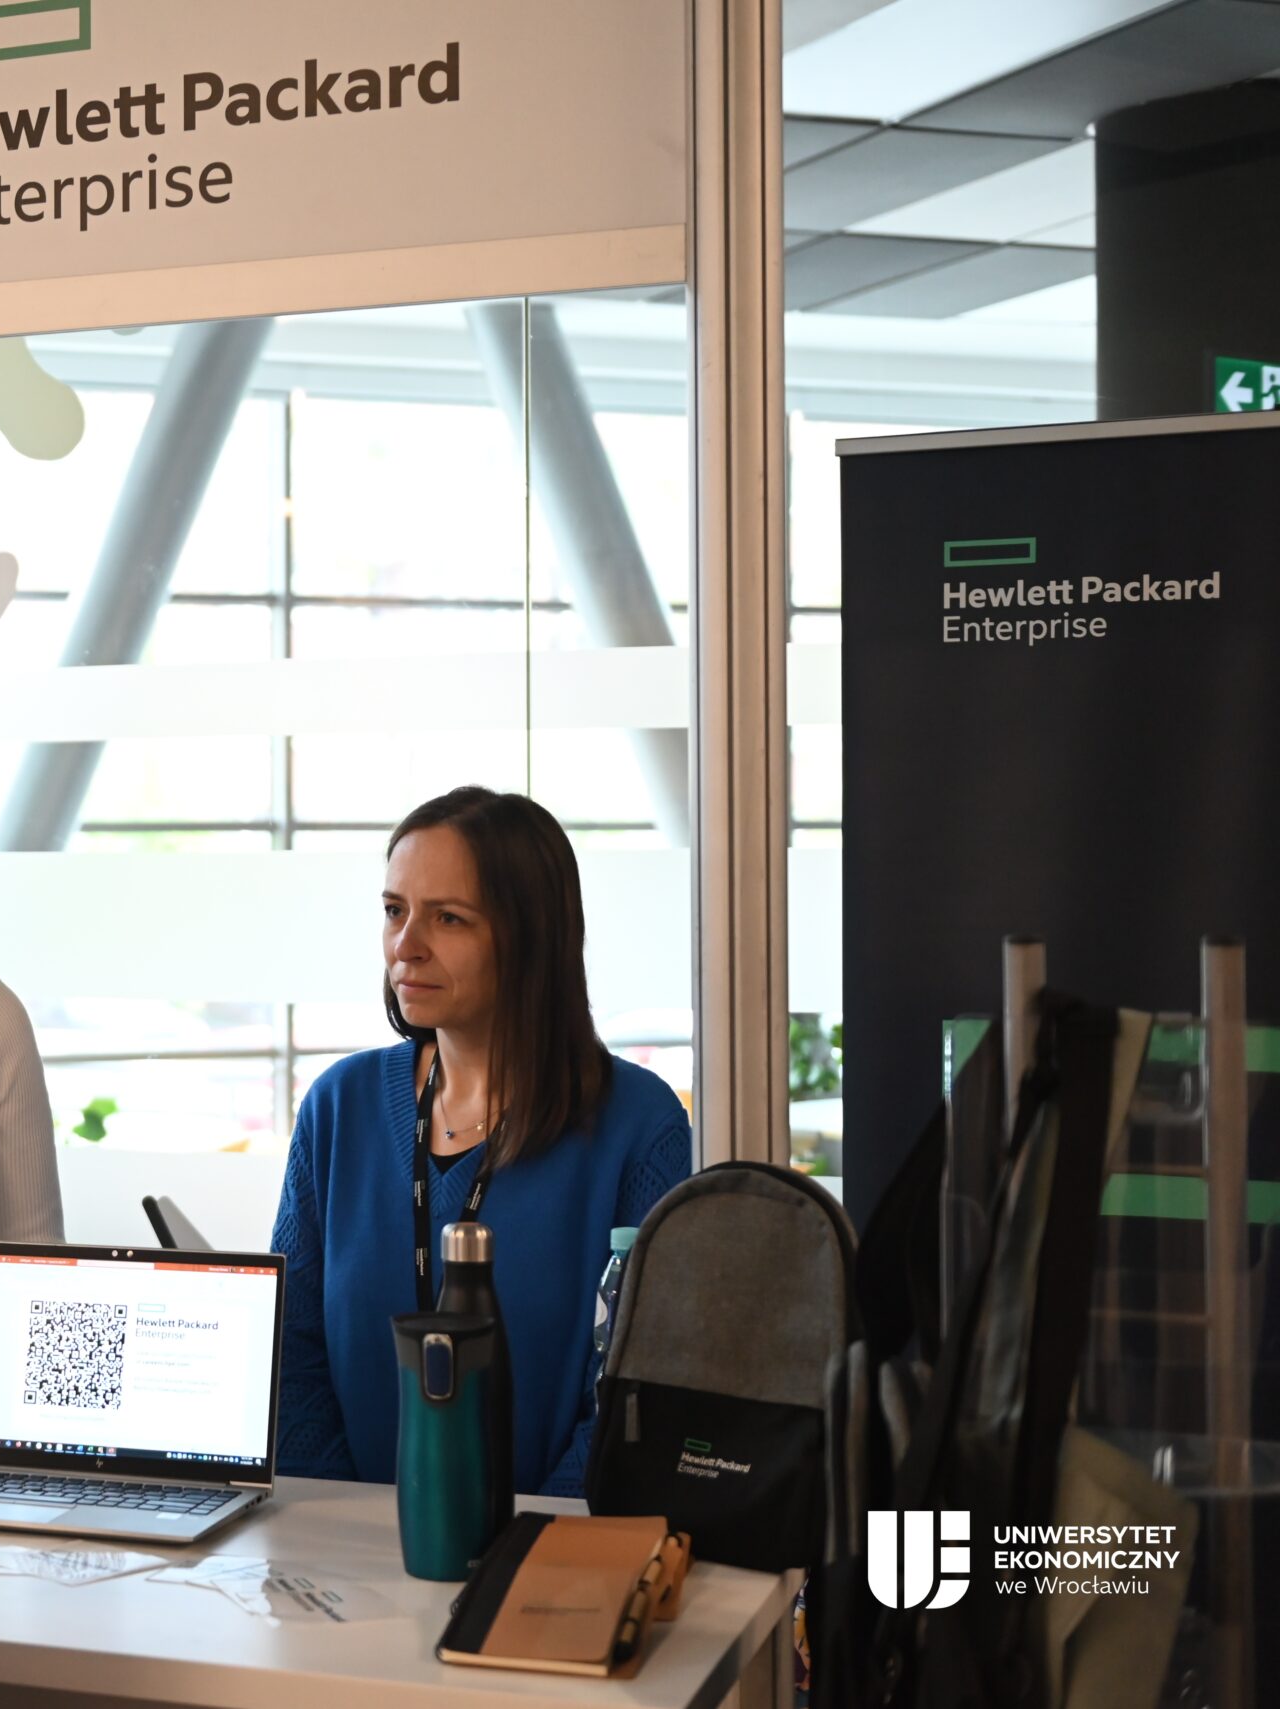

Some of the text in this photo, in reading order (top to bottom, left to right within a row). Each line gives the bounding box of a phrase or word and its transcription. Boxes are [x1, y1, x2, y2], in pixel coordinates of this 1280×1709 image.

[183, 42, 460, 131] Packard
[943, 571, 1220, 609] Hewlett Packard
[943, 612, 1107, 646] Enterprise
[136, 1317, 219, 1330] Hewlett Packard
[678, 1462, 719, 1479] Enterprise
[715, 1458, 751, 1473] Packard
